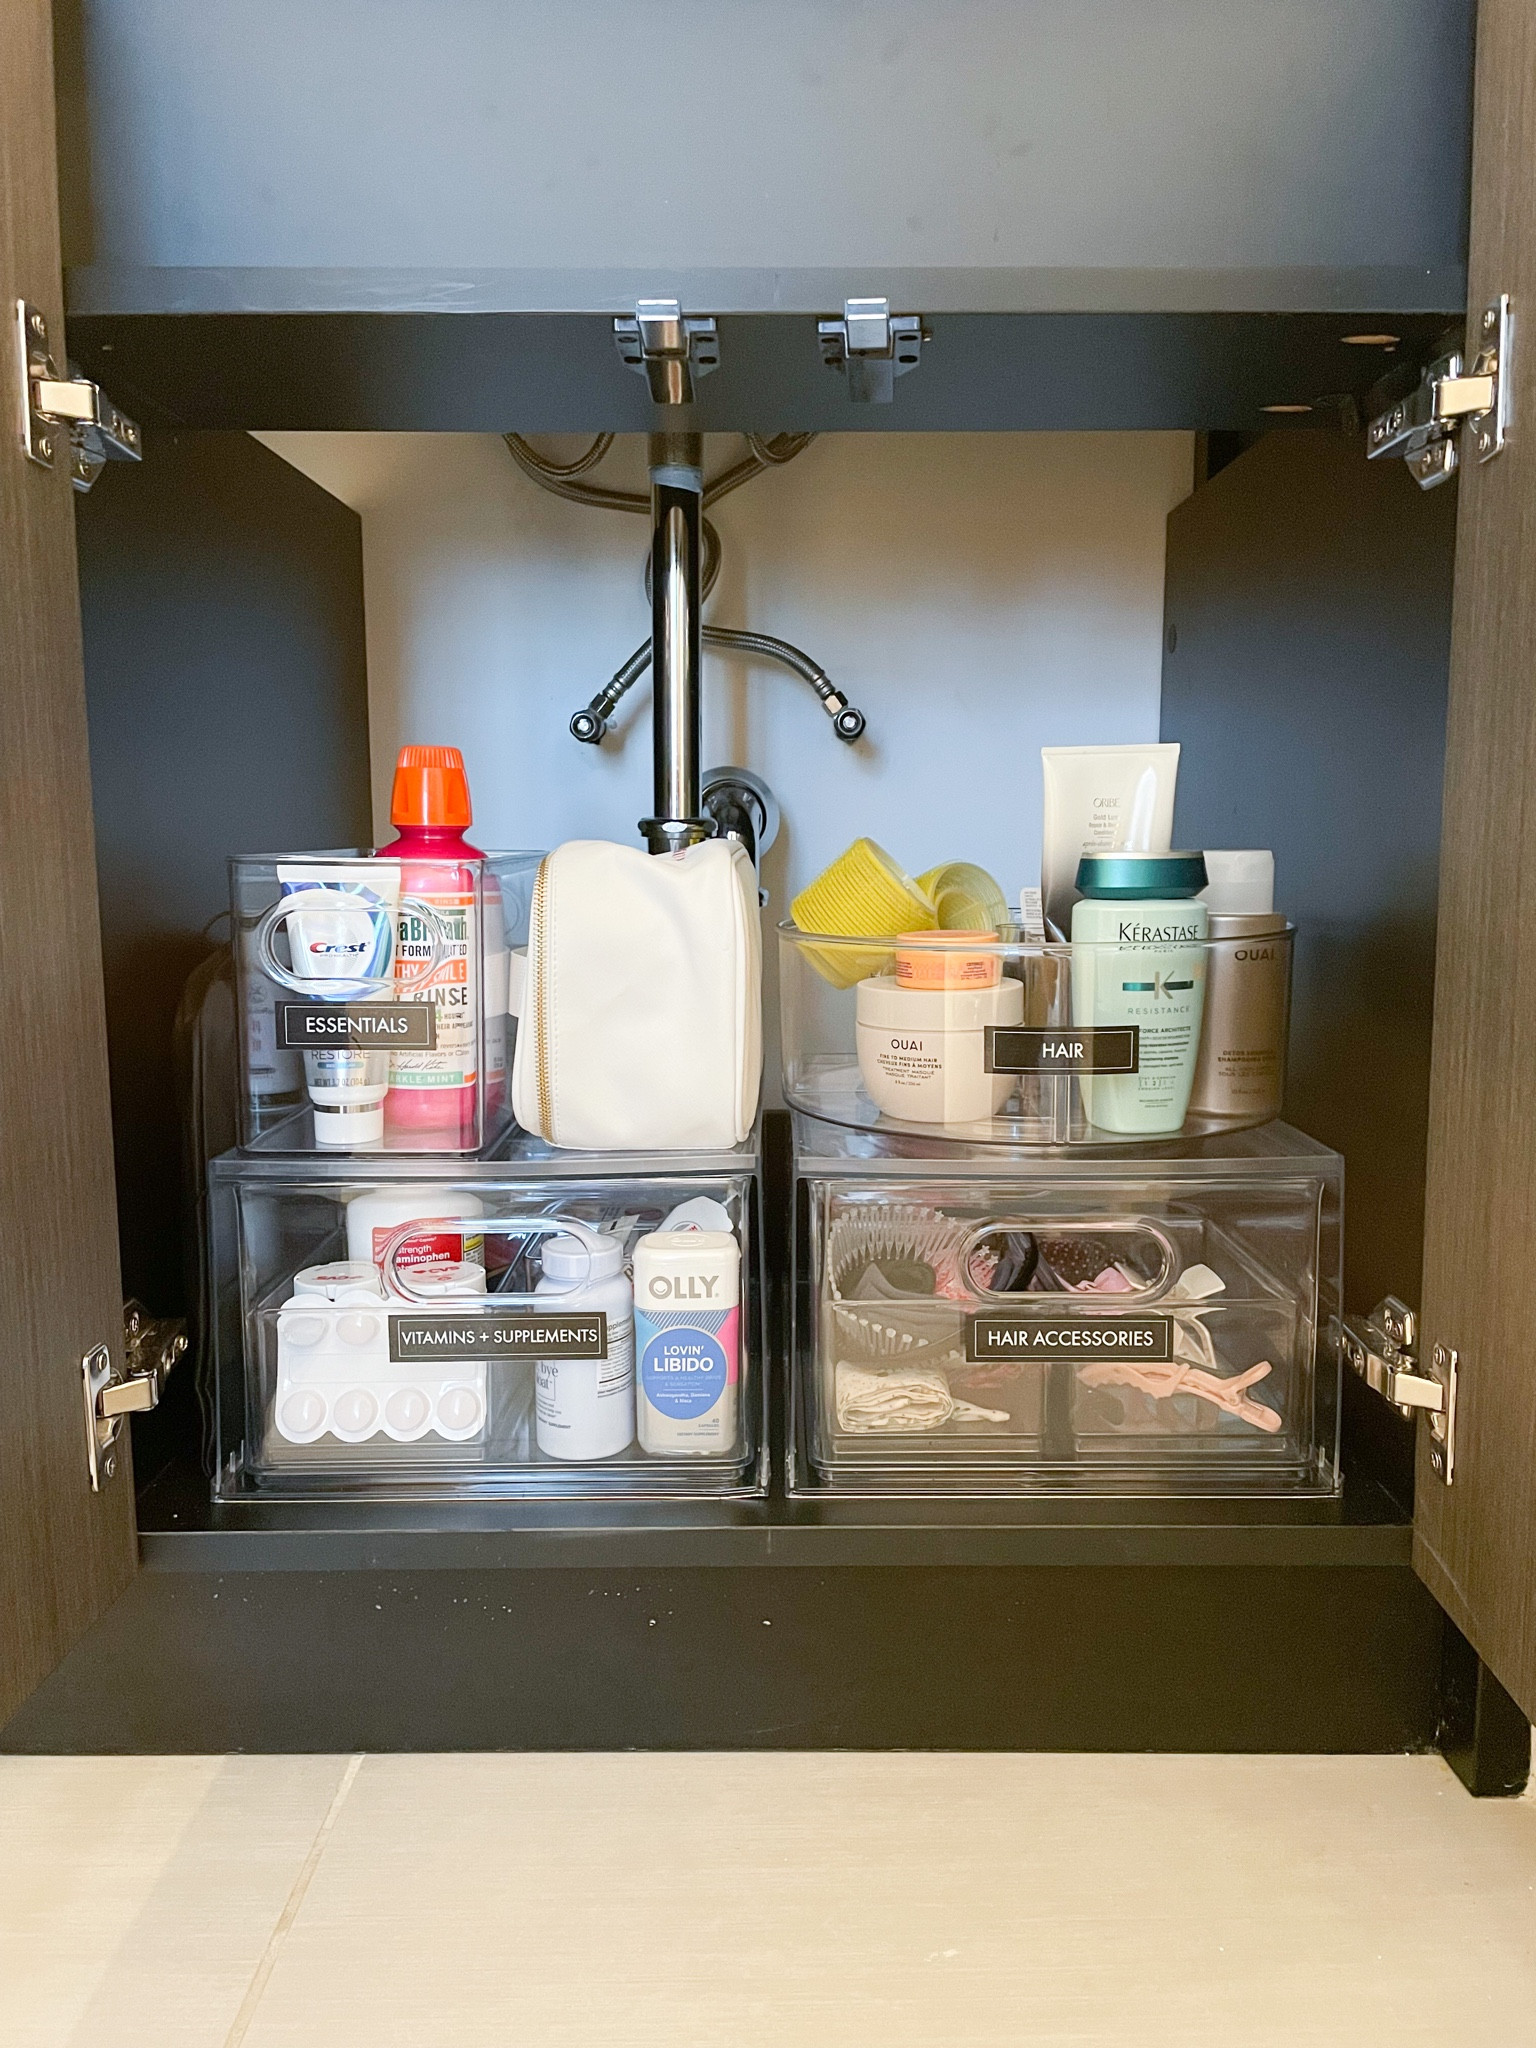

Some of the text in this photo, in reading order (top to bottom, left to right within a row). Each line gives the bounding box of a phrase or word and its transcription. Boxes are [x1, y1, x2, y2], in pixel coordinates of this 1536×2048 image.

[1093, 798, 1121, 808] ORIBE
[1119, 922, 1199, 942] KÉRASTASE
[310, 942, 366, 953] Crest
[1235, 949, 1275, 961] OUAI
[1128, 1006, 1190, 1015] RESISTANCE
[305, 1016, 408, 1034] ESSENTIALS
[891, 1039, 923, 1051] OUAI
[1043, 1042, 1084, 1059] HAIR
[311, 1050, 370, 1060] RESTORE
[427, 1074, 455, 1082] MINT
[648, 1275, 719, 1299] OLLY
[401, 1328, 598, 1345] VITAMINS + SUPPLEMENTS
[988, 1330, 1153, 1346] HAIR ACCESSORIES
[653, 1357, 714, 1372] LIBIDO
